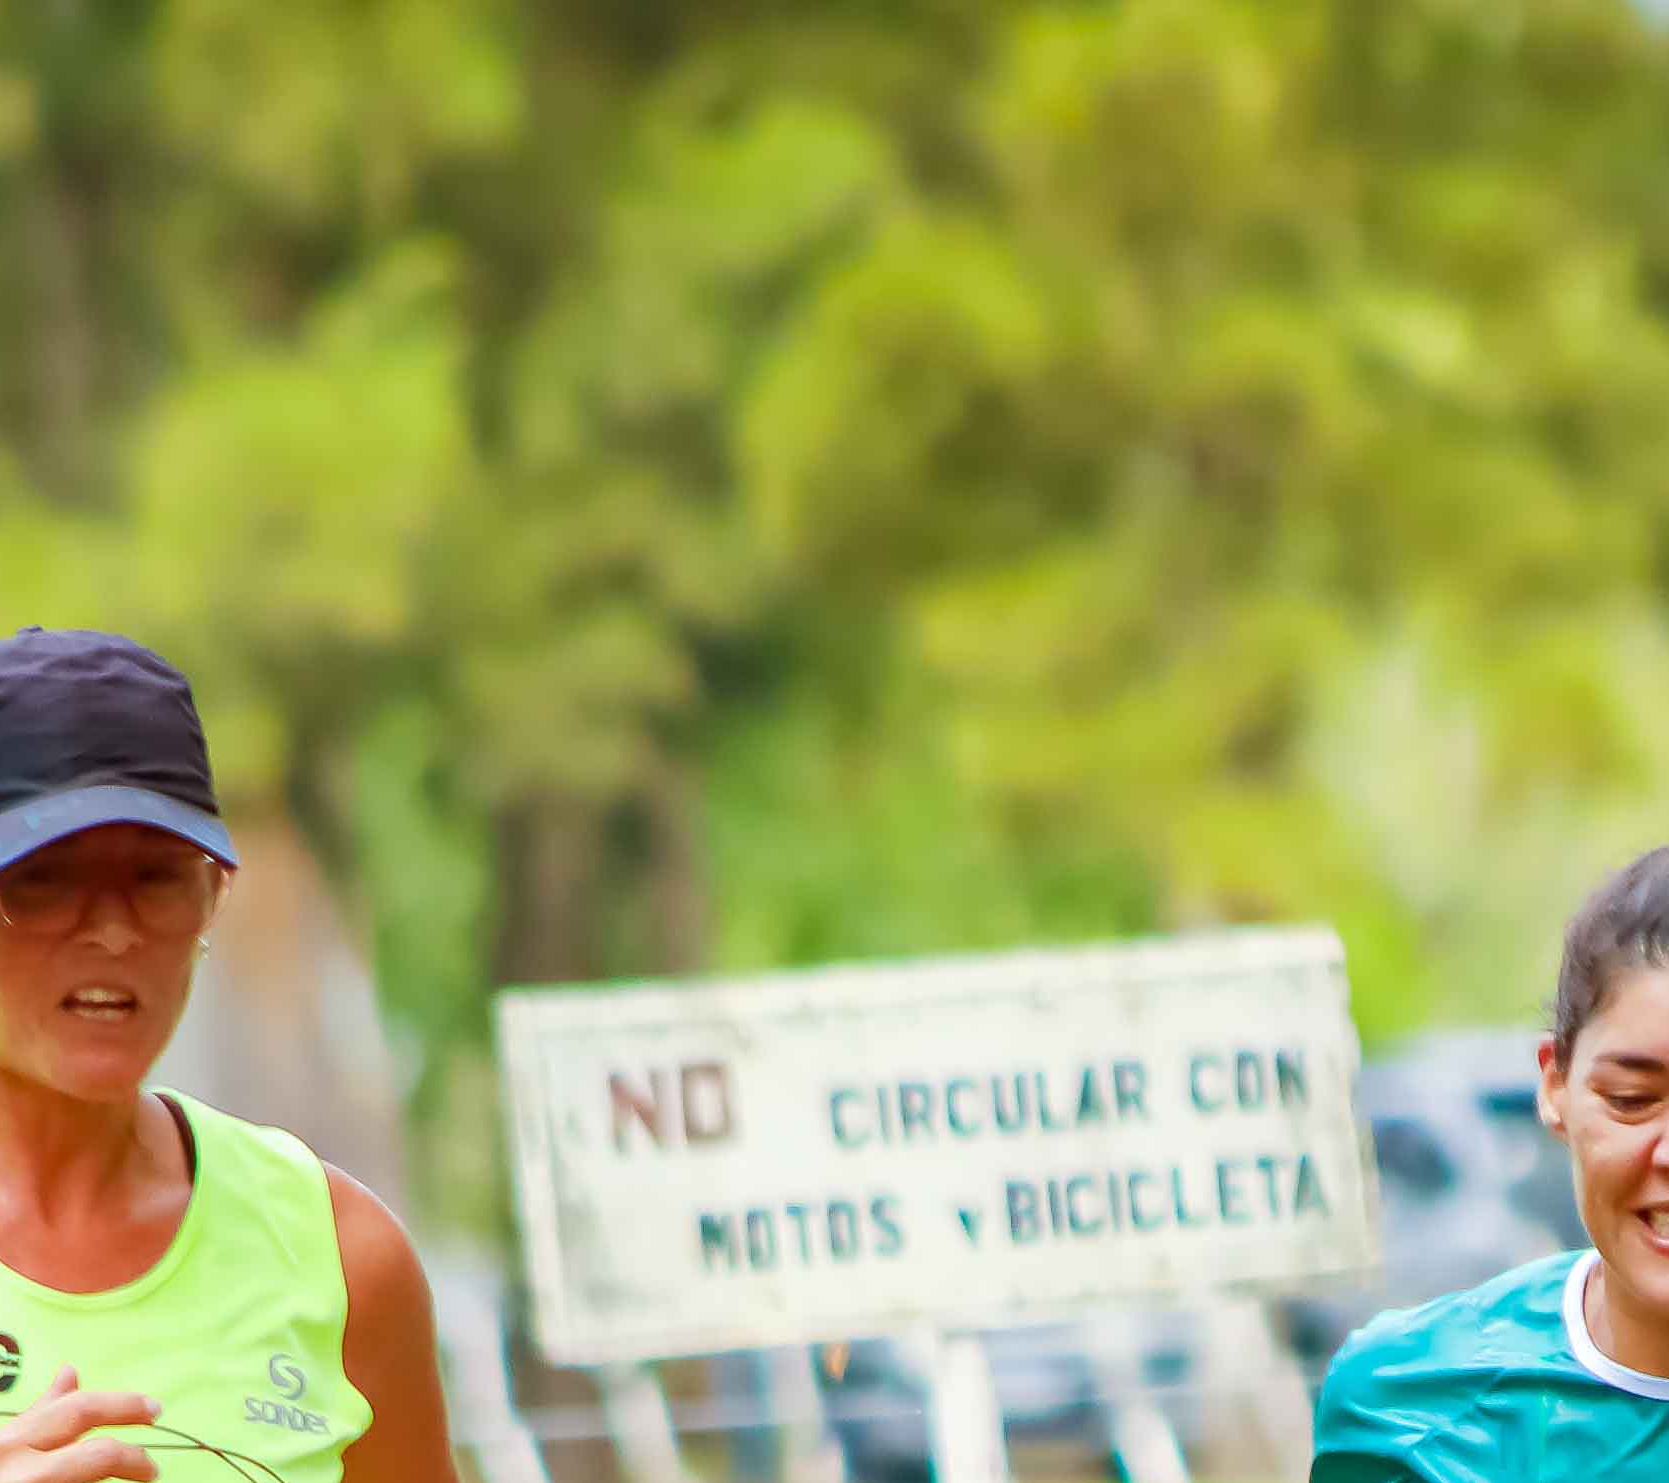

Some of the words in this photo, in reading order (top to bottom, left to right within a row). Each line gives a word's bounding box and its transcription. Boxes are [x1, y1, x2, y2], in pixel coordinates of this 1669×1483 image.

[607, 1061, 734, 1152] NO
[829, 1058, 1149, 1149] CIRCULAR
[1188, 1045, 1308, 1114] CON
[697, 1195, 906, 1272] MOTOS
[1004, 1151, 1329, 1244] BICICLETA
